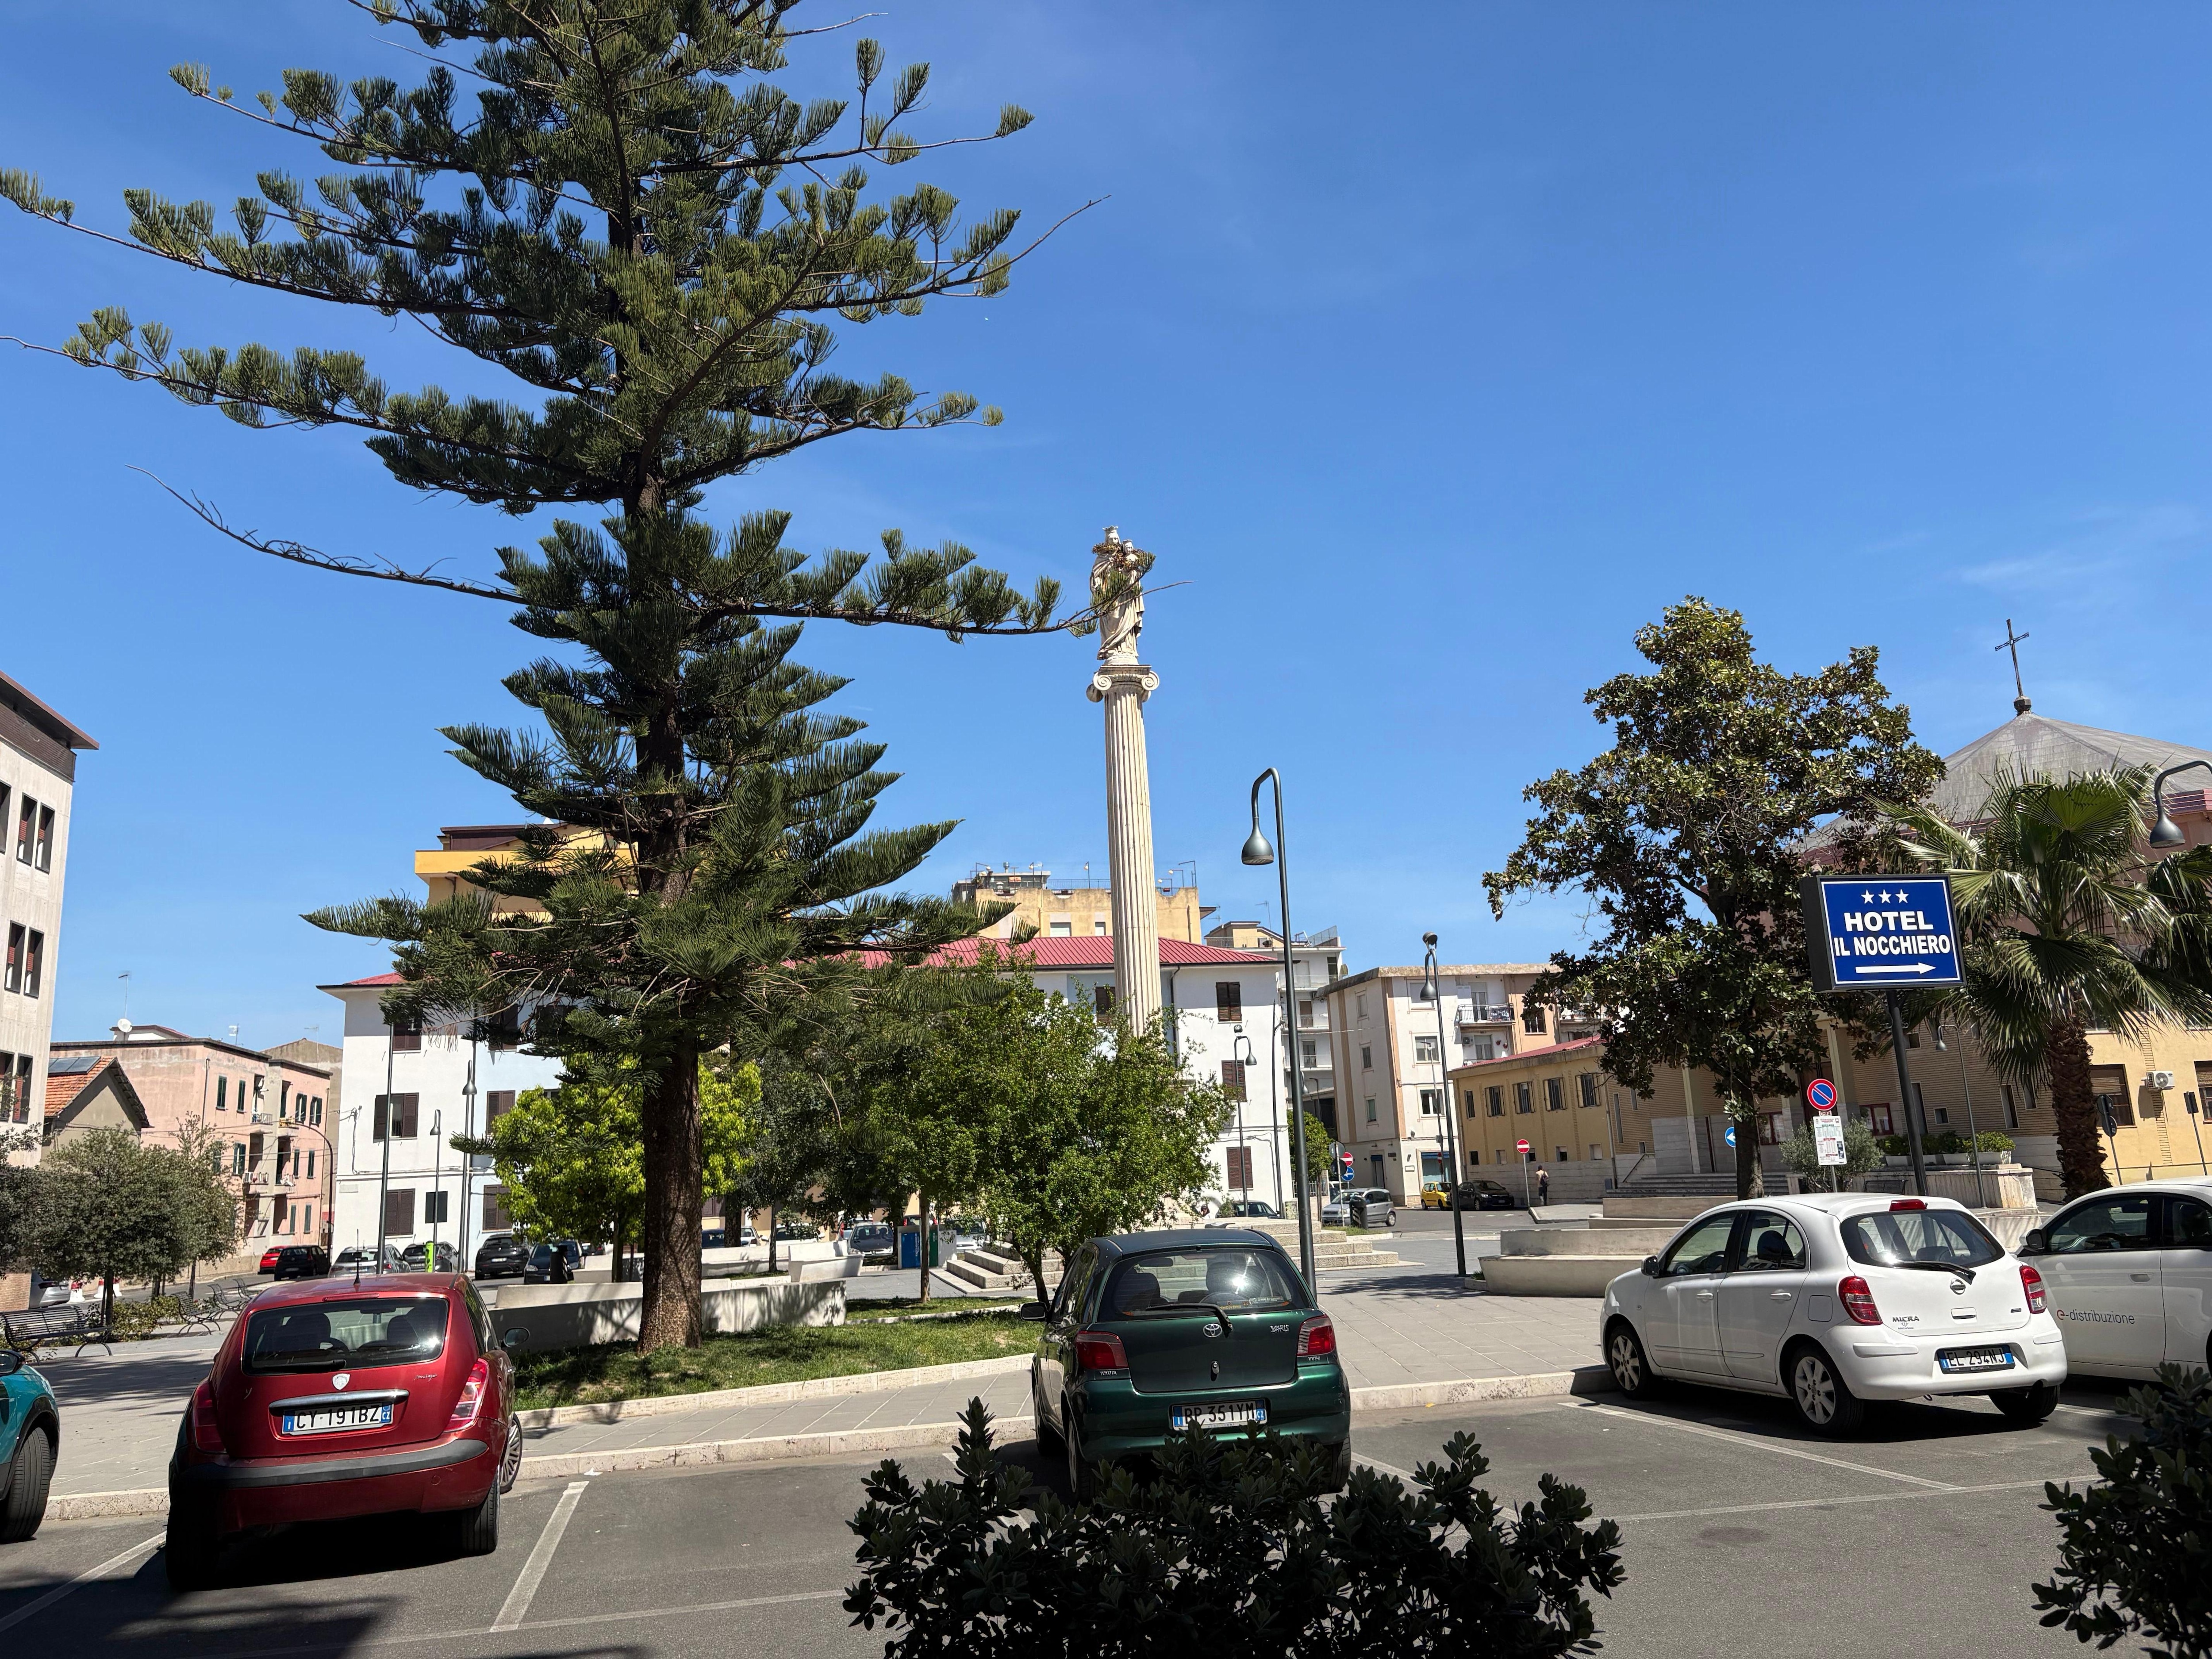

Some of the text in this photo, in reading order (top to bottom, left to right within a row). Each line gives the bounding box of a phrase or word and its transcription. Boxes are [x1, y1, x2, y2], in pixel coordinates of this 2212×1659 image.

[1844, 911, 1934, 932] HOTEL
[1834, 934, 1951, 956] IL NOCCHIERO
[2057, 1309, 2135, 1324] e-distribuzione
[1947, 1348, 2005, 1367] EL 294NJ
[296, 1405, 380, 1429] CY 191BZ
[382, 1411, 390, 1420] CZ
[1184, 1402, 1255, 1424] BP 351YM
[1257, 1409, 1264, 1418] CZ
